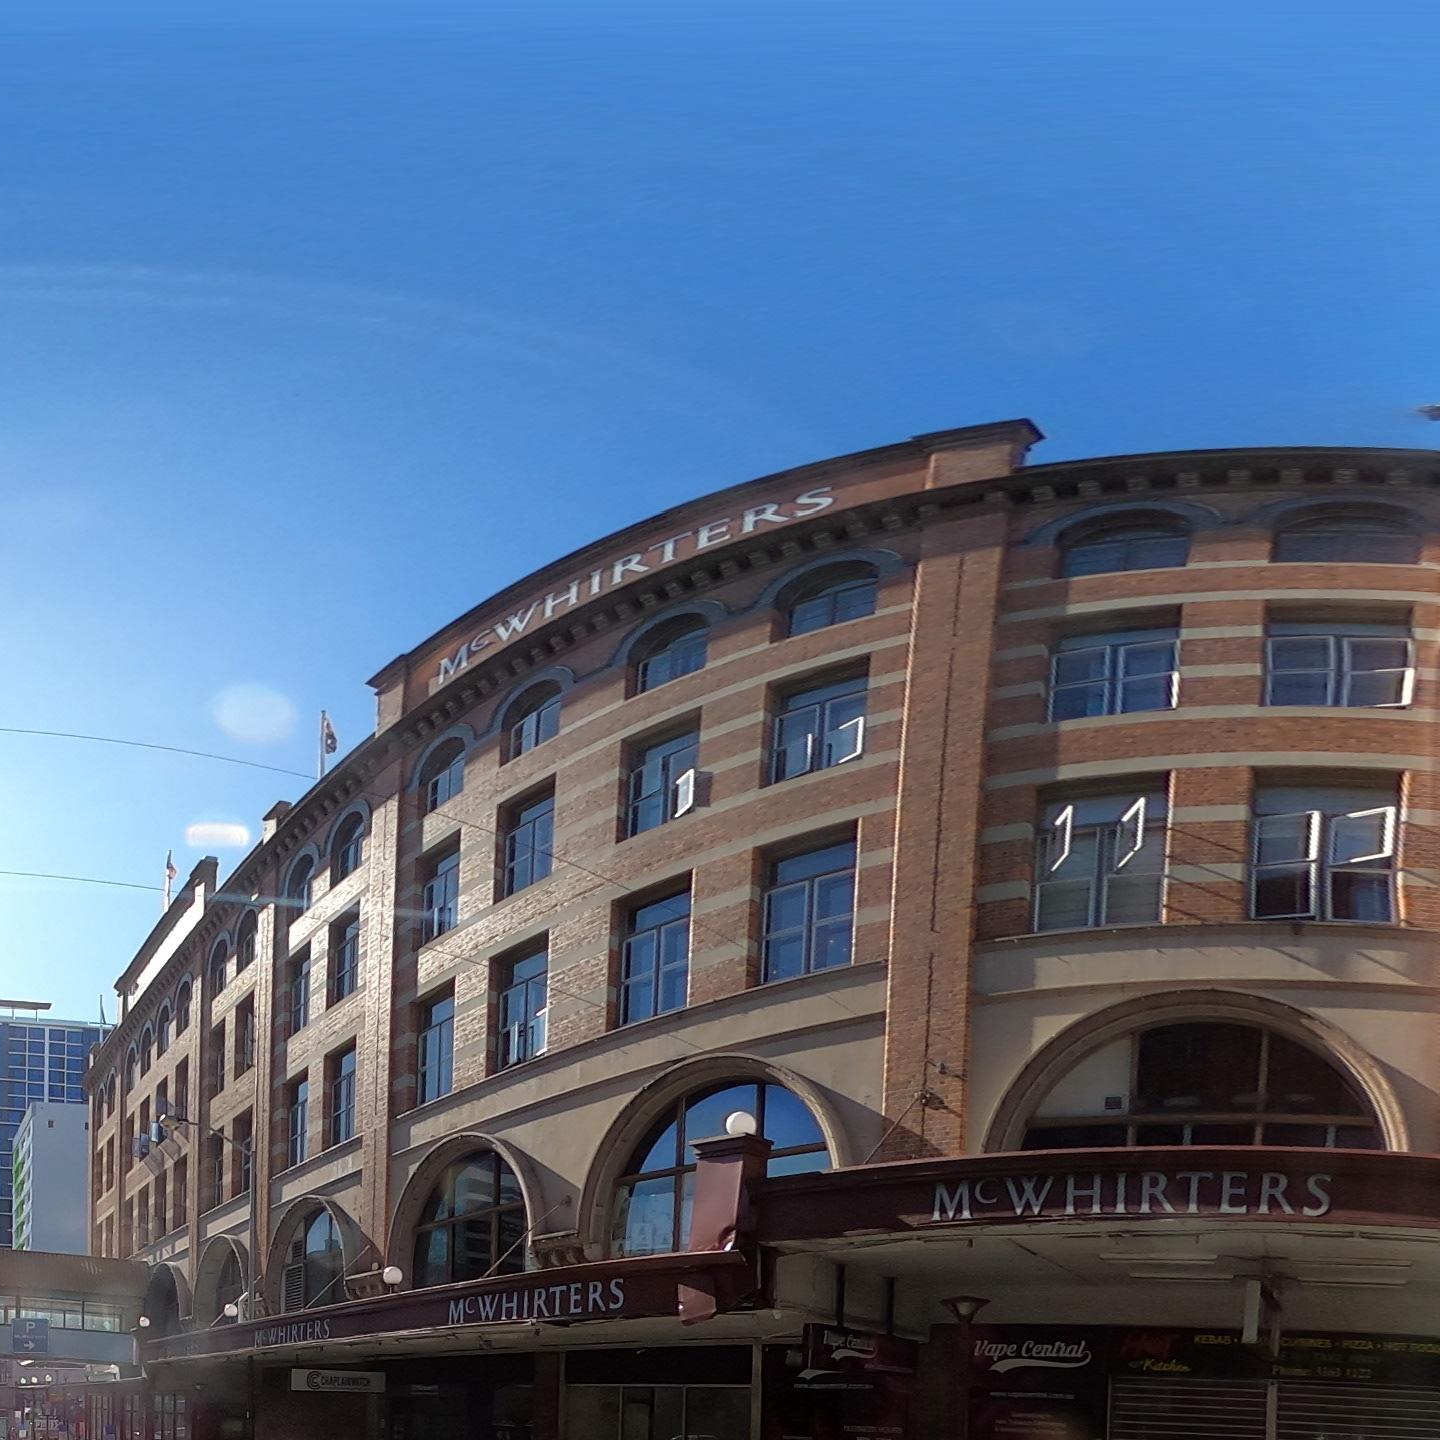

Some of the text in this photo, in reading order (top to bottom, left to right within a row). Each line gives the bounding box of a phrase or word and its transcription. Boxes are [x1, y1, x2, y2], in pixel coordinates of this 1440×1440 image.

[26, 1321, 36, 1333] P
[973, 1339, 1087, 1361] Vape Central
